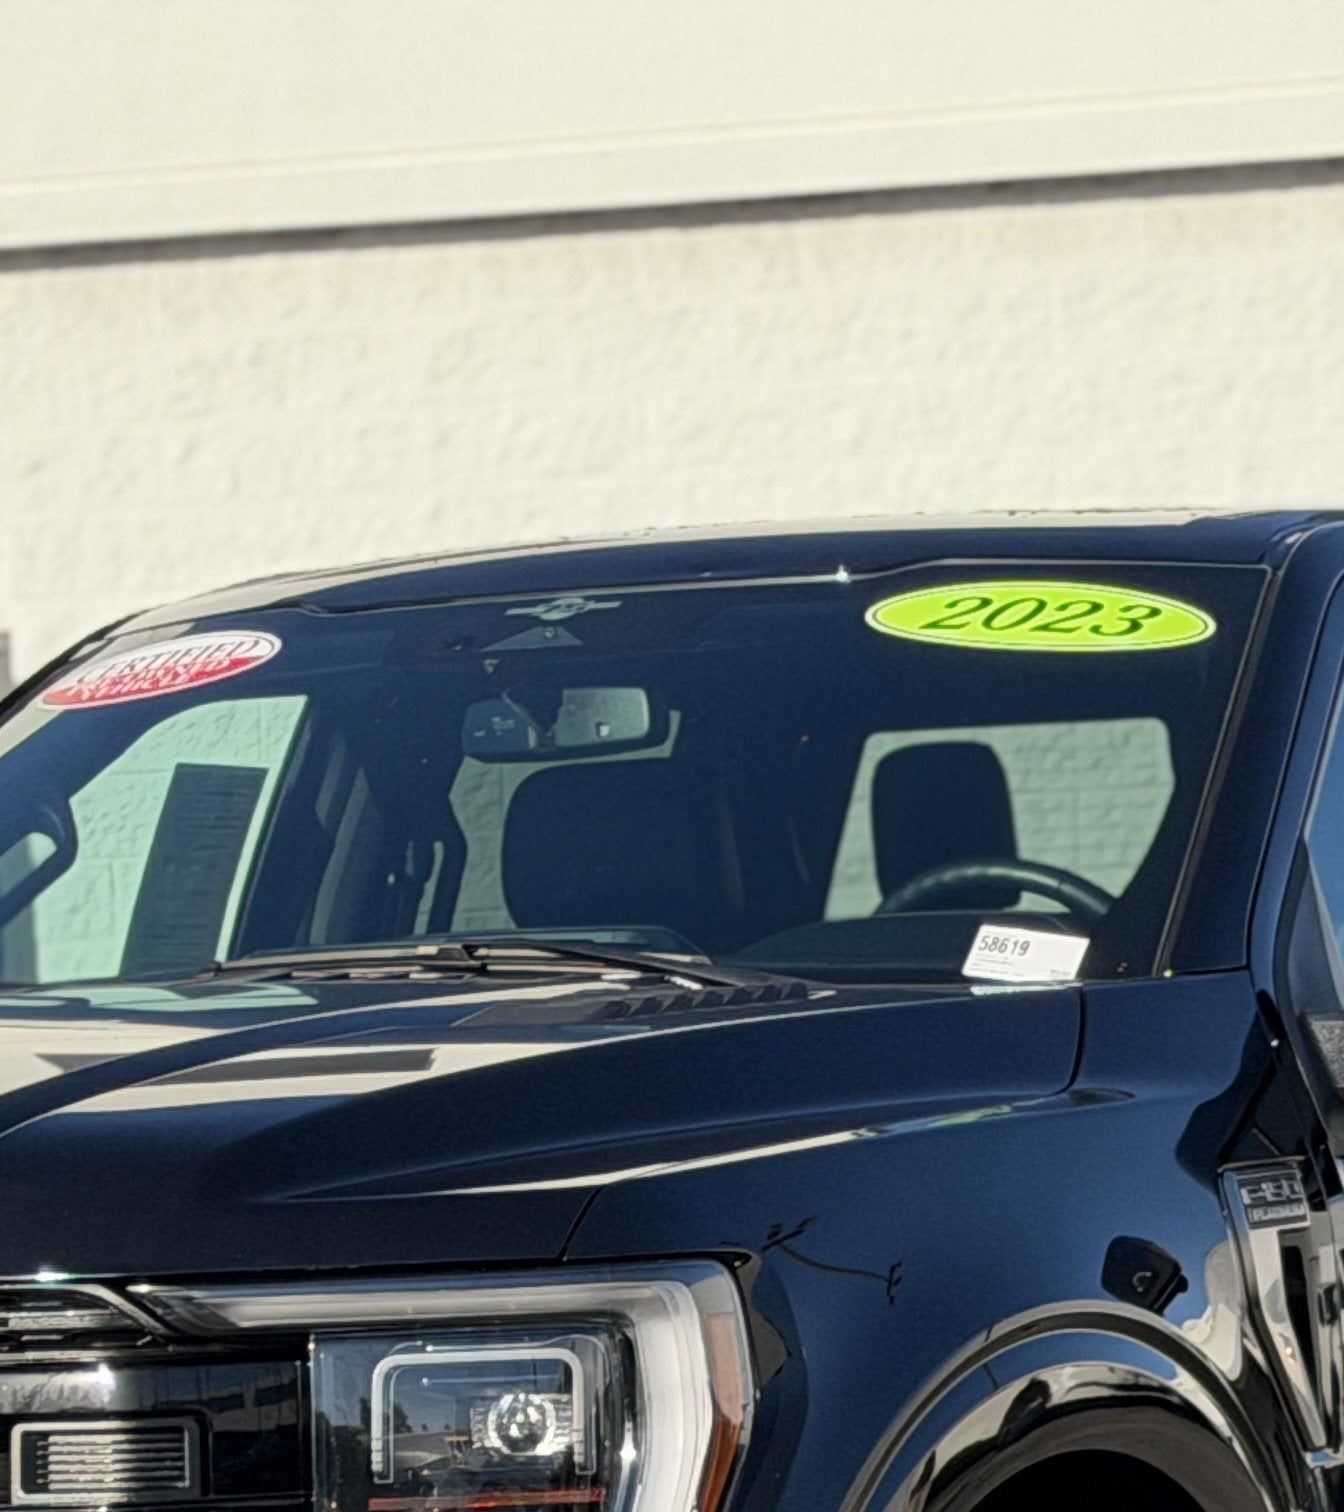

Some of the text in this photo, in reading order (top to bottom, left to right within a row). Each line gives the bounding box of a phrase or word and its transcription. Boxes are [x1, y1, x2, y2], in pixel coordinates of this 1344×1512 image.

[918, 596, 1163, 636] 2023
[76, 640, 260, 684] CERTIFIED
[978, 935, 1031, 957] 58619
